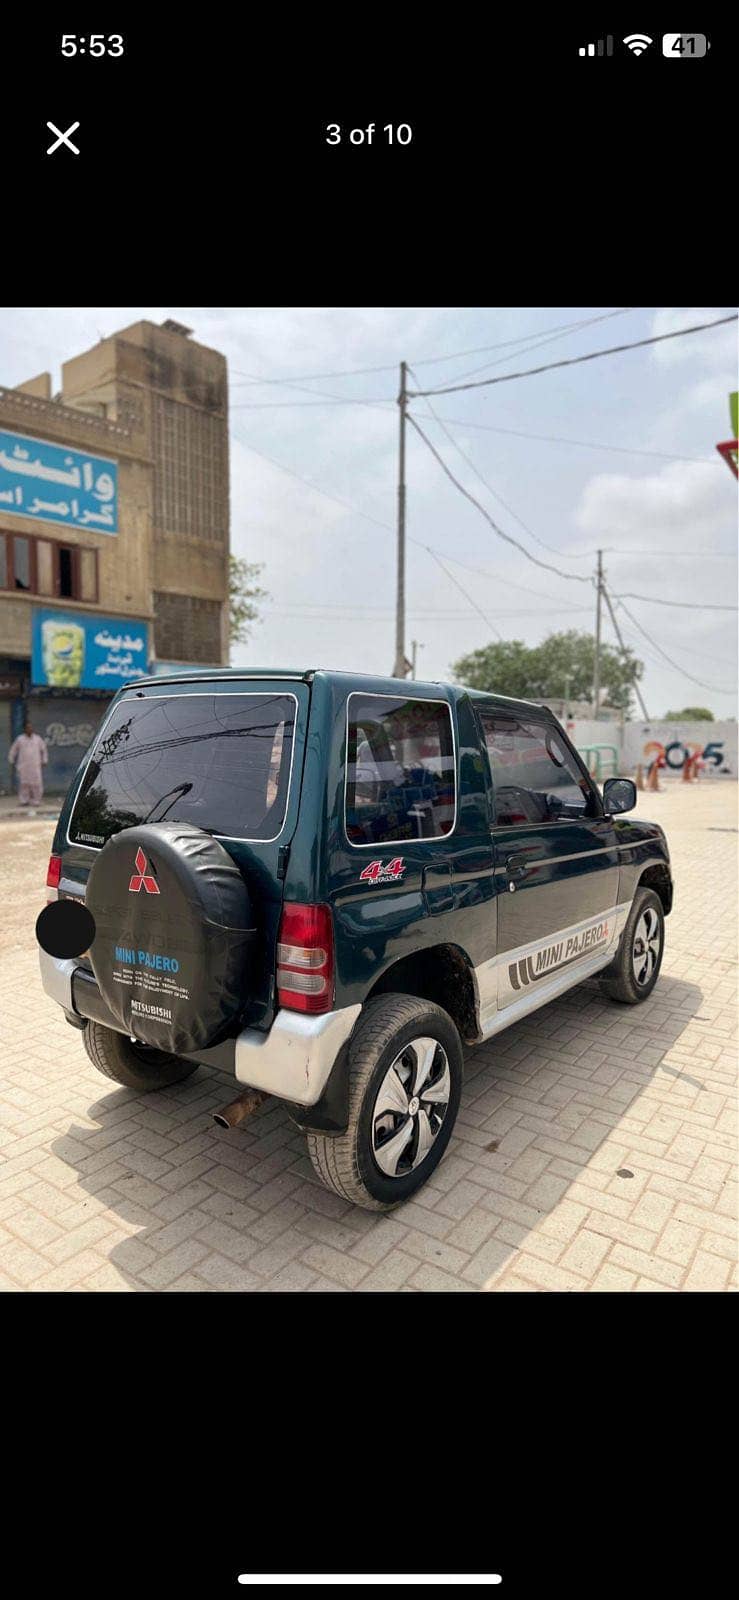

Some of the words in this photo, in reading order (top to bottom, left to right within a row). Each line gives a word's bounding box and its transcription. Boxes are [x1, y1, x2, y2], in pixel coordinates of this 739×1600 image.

[643, 741, 724, 769] 2025
[115, 946, 136, 965] MINI
[138, 950, 179, 973] PAJERO
[535, 942, 563, 972] MINI
[565, 923, 604, 957] PAJERO
[131, 999, 172, 1019] MITSUBISHI
